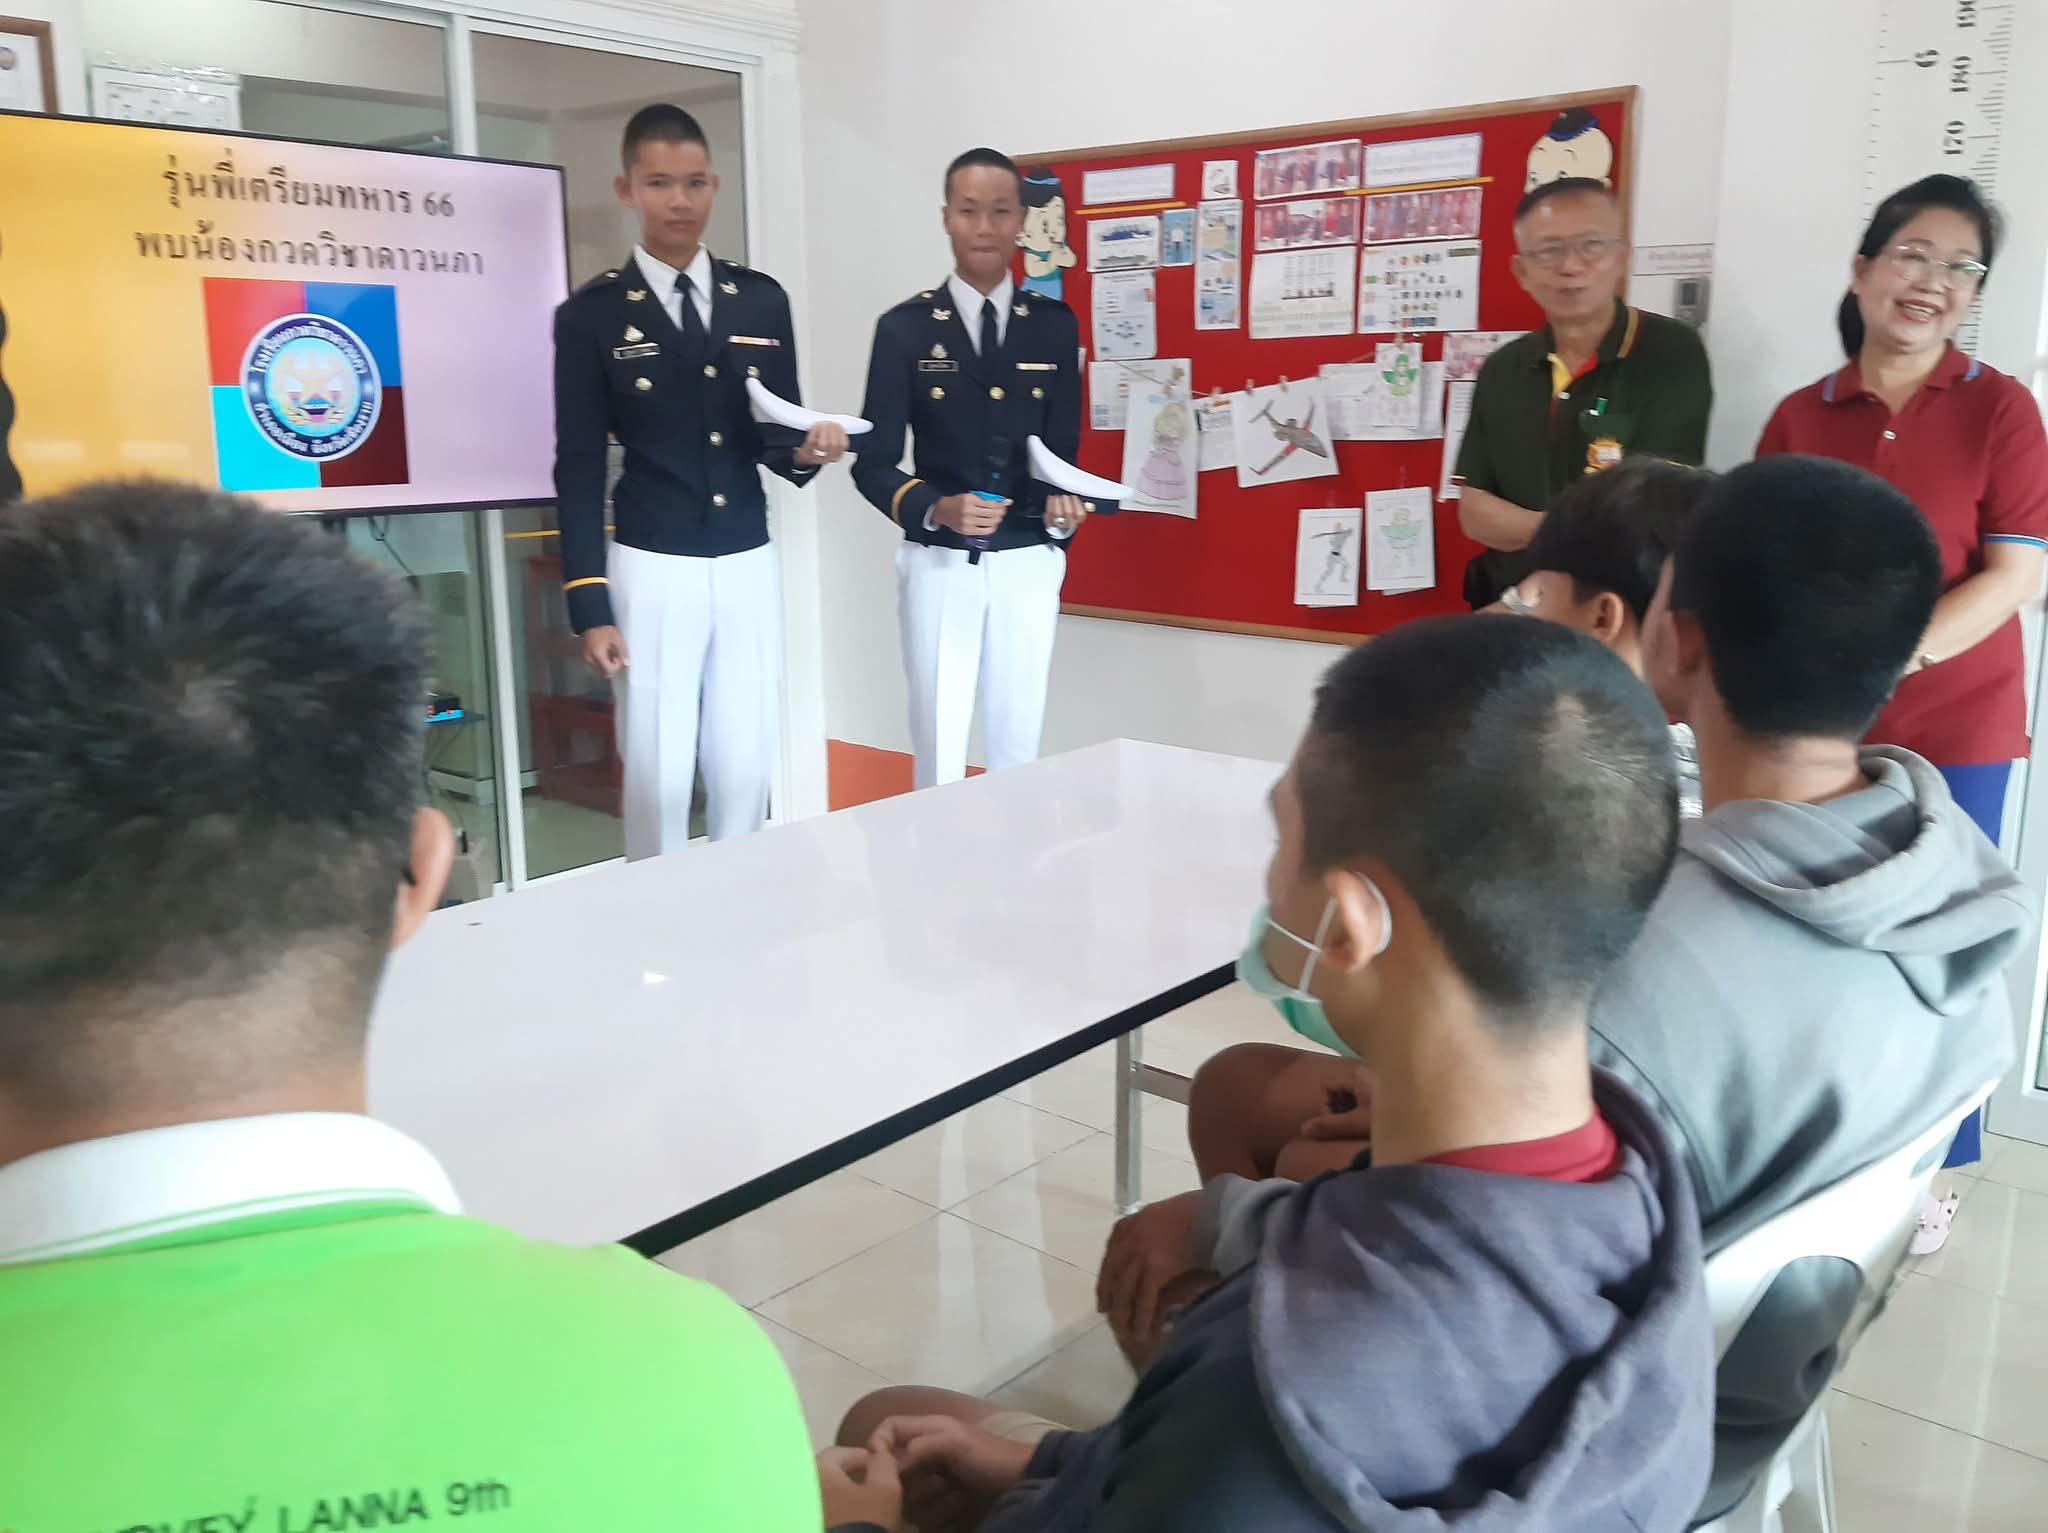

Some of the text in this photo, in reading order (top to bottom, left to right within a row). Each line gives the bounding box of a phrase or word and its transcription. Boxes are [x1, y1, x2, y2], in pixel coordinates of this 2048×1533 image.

[1914, 49, 1939, 68] 6
[1949, 55, 1972, 92] 180
[1943, 119, 1966, 155] 170
[423, 191, 456, 218] 66
[278, 1487, 429, 1533] LANNA
